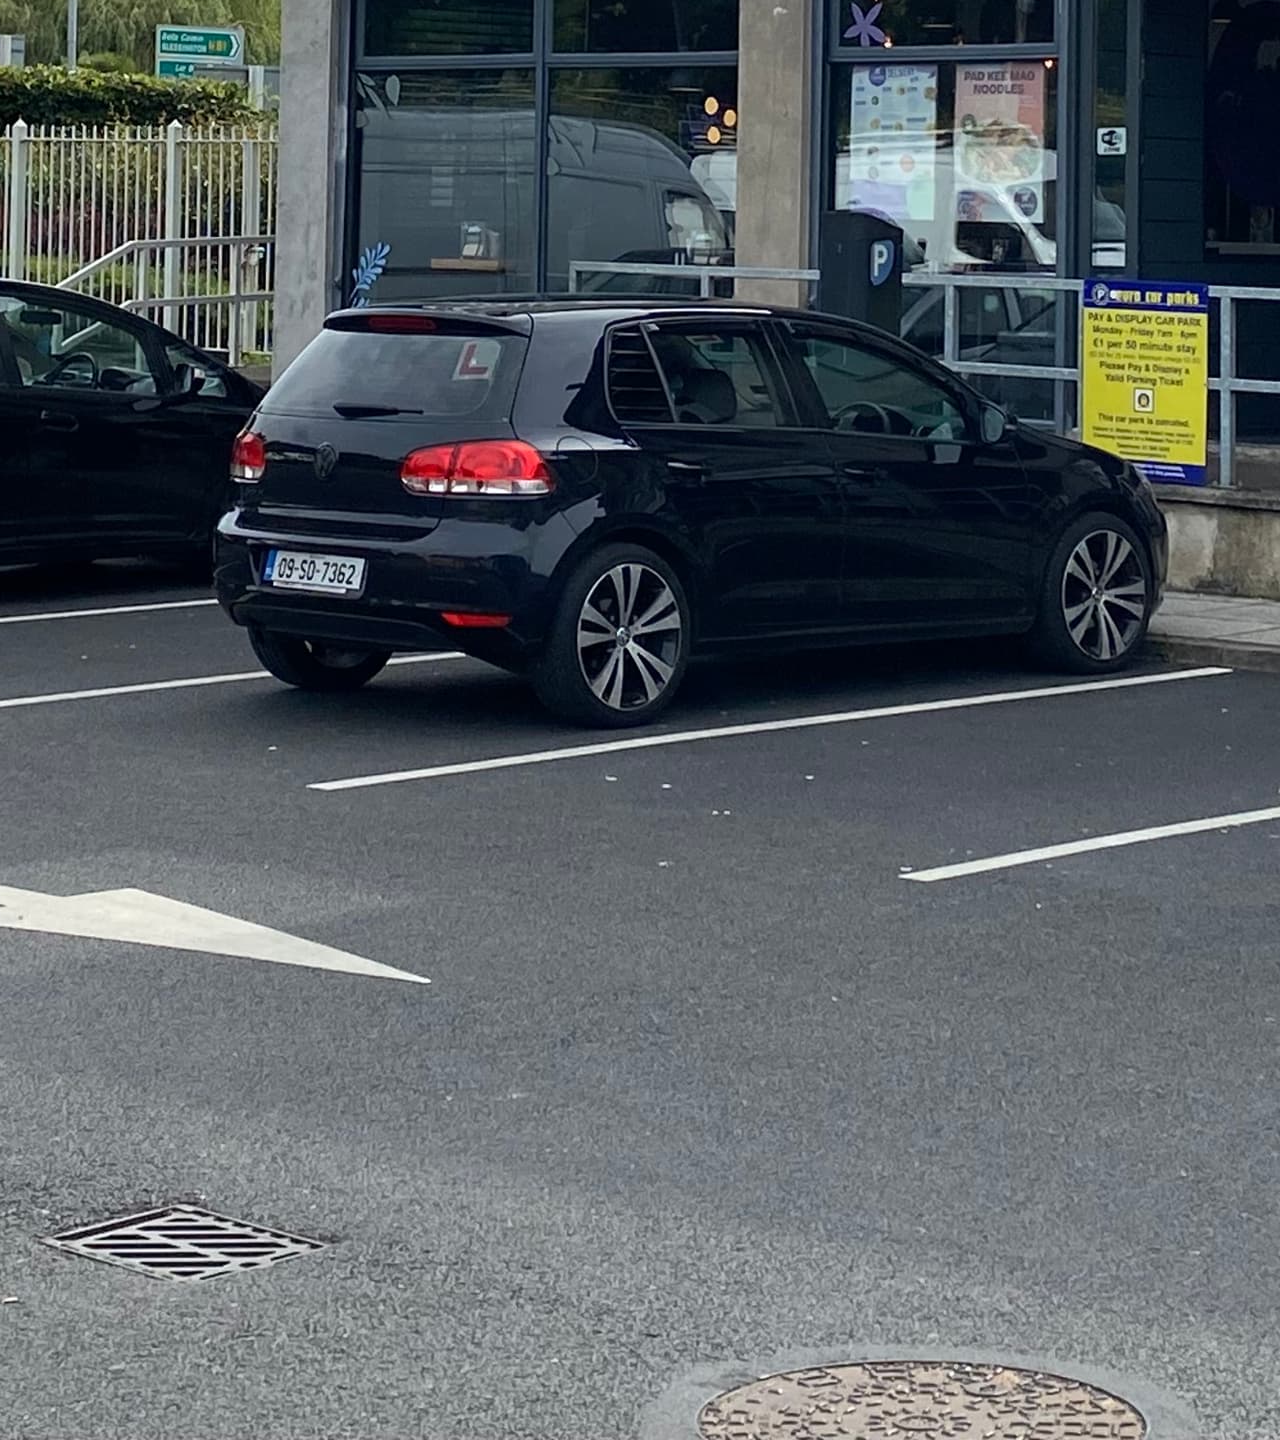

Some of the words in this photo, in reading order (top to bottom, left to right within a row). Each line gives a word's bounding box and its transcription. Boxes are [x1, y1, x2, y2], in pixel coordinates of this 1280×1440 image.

[964, 71, 985, 81] PAD
[987, 71, 1008, 81] KEE
[1010, 70, 1035, 81] MAO
[973, 84, 1024, 95] NOODLES
[873, 243, 888, 277] P
[1088, 312, 1104, 322] PAY
[1107, 314, 1113, 322] &
[1115, 314, 1152, 325] DISPLAY
[1155, 316, 1175, 326] CAR
[1177, 317, 1202, 328] PARK
[1093, 325, 1122, 335] Monday
[1130, 327, 1154, 338] Friday
[1107, 341, 1122, 350] per
[1140, 341, 1173, 352] minute
[1176, 343, 1197, 355] stay
[459, 343, 489, 376] L
[1100, 360, 1125, 371] Please
[1128, 362, 1142, 373] Pay
[1126, 374, 1157, 387] Parking
[1159, 376, 1184, 386] Ticket
[1099, 412, 1113, 422] This
[278, 556, 357, 585] 09-SO-7362
